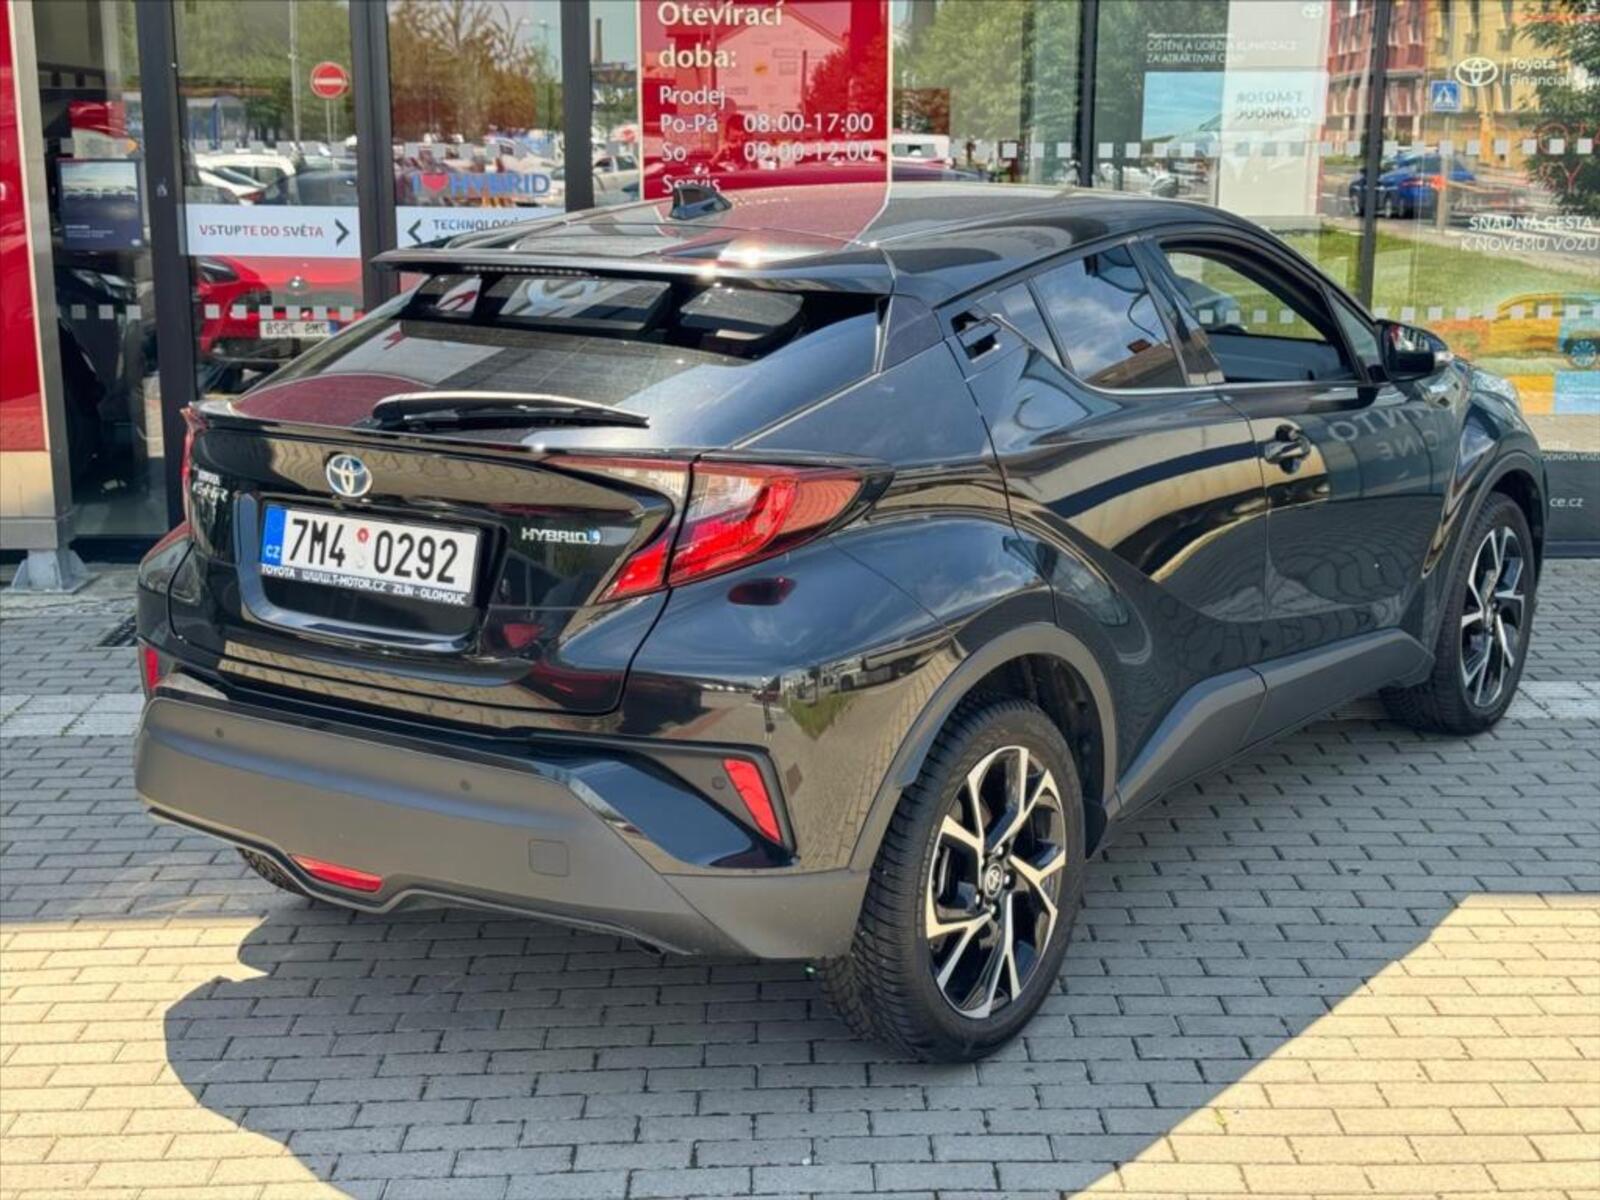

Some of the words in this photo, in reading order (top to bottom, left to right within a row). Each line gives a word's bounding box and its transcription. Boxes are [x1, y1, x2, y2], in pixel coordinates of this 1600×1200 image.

[658, 1, 782, 26] Otevírací
[659, 43, 737, 68] doba:
[1511, 58, 1557, 72] Toyota
[660, 86, 725, 108] Prodej
[660, 113, 718, 133] Po-Pá
[743, 112, 873, 133] 08:00-17:00
[662, 142, 687, 162] So
[743, 141, 873, 162] 09:00-12:00
[452, 173, 551, 196] HYBRID
[198, 224, 258, 237] VSTUPTE
[260, 225, 280, 237] DO
[521, 526, 588, 545] HYBRID
[265, 545, 281, 559] CZ
[289, 518, 346, 568] 7M4
[373, 529, 458, 584] 0292
[260, 564, 296, 579] TOYOTA
[420, 586, 467, 605] OLOMOUC
